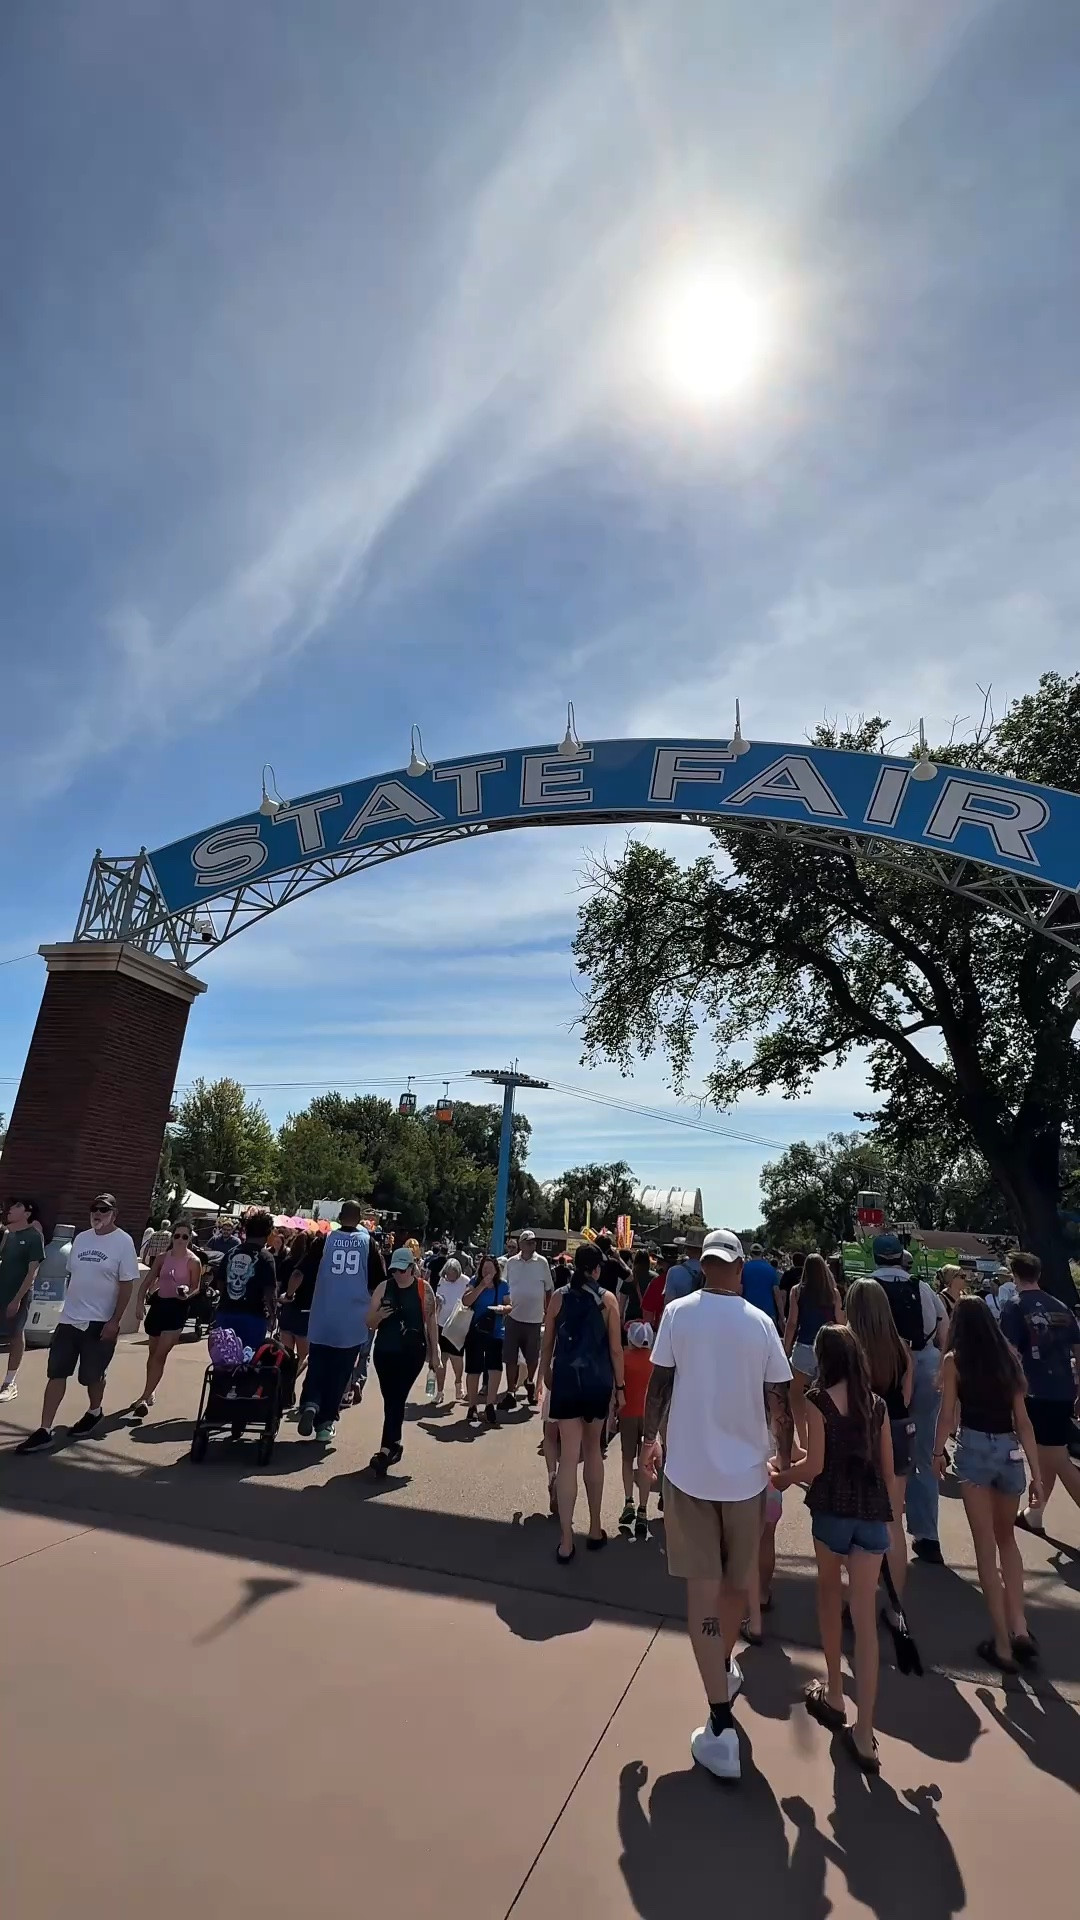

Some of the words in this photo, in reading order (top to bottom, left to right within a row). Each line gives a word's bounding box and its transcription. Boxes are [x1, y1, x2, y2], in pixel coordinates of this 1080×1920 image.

[191, 747, 595, 888] STATE
[647, 746, 1051, 867] FAIR
[331, 1249, 361, 1275] 99
